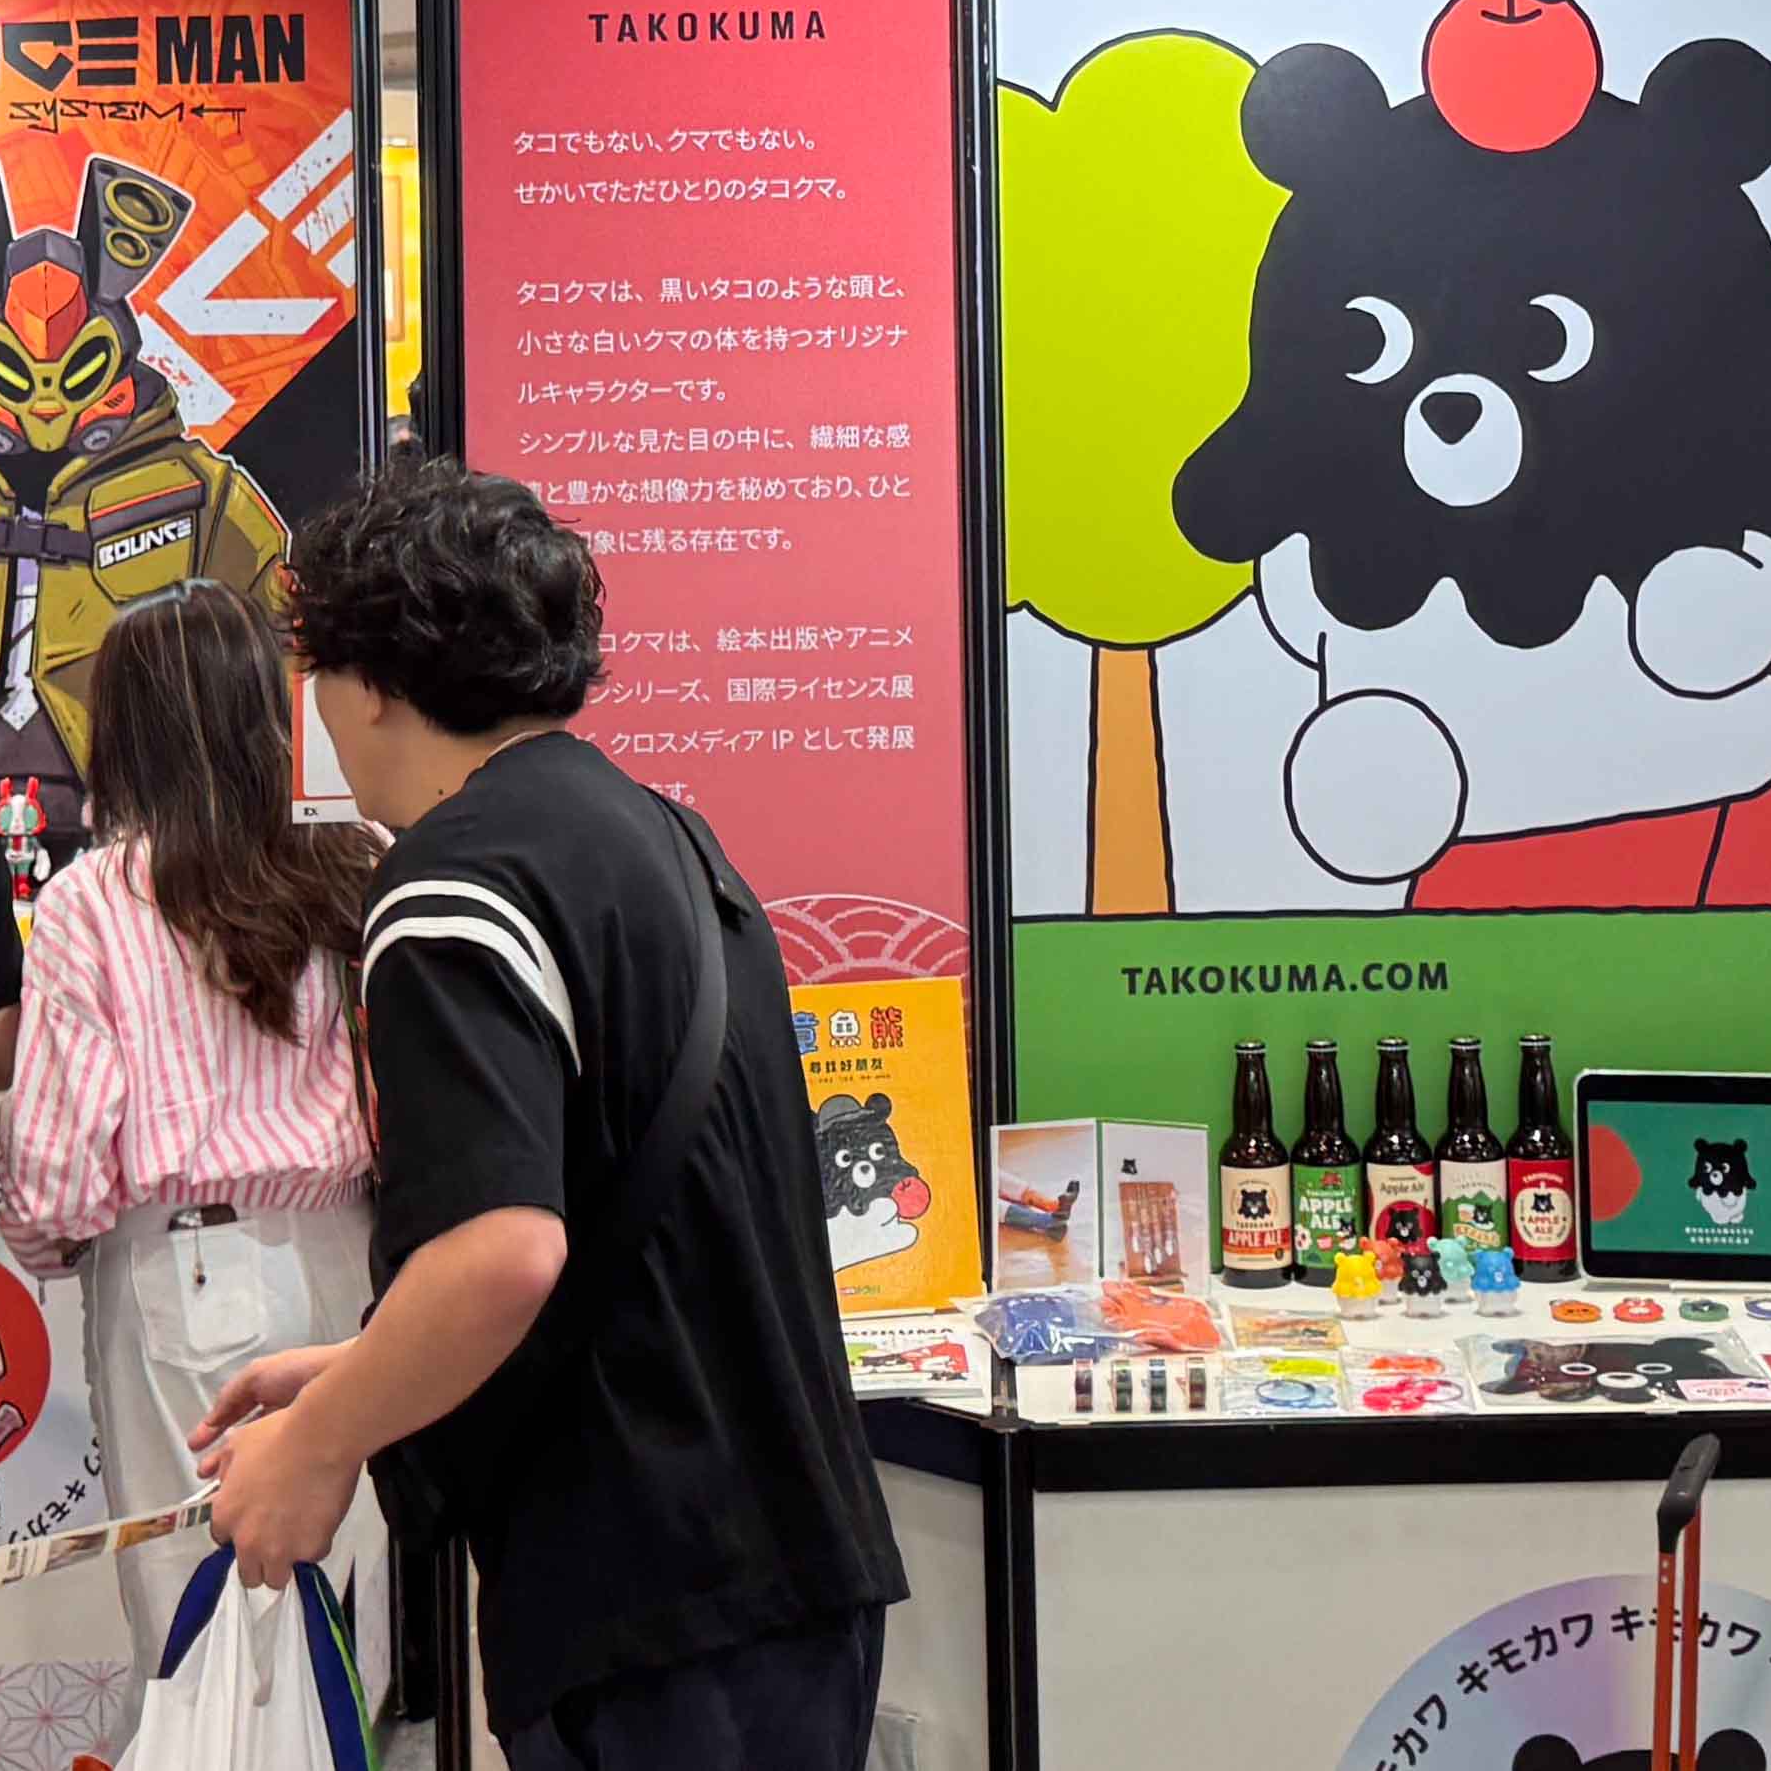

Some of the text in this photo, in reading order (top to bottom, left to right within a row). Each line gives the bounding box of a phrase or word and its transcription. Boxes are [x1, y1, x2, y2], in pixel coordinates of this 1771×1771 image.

[587, 10, 828, 44] TAKOKUMA
[155, 14, 306, 86] MAN
[514, 127, 817, 156] タコでもない、クマでもない。
[514, 175, 848, 206] せかいでただひとりのタコクマ。
[517, 274, 907, 305] タコクマは、黒いタコのような頭と、
[517, 324, 911, 356] 小さな白いクマの体を持つオリジナ
[518, 378, 728, 406] ルキャラクターです。
[519, 423, 912, 455] シンプルな見た目の中に、繊細な感
[98, 516, 192, 569] BOUNCE
[1121, 961, 1450, 996] TAKOKUMA.COM
[1299, 1196, 1354, 1214] APPLE
[1311, 1214, 1342, 1230] ALE
[1227, 1229, 1263, 1247] APPLE
